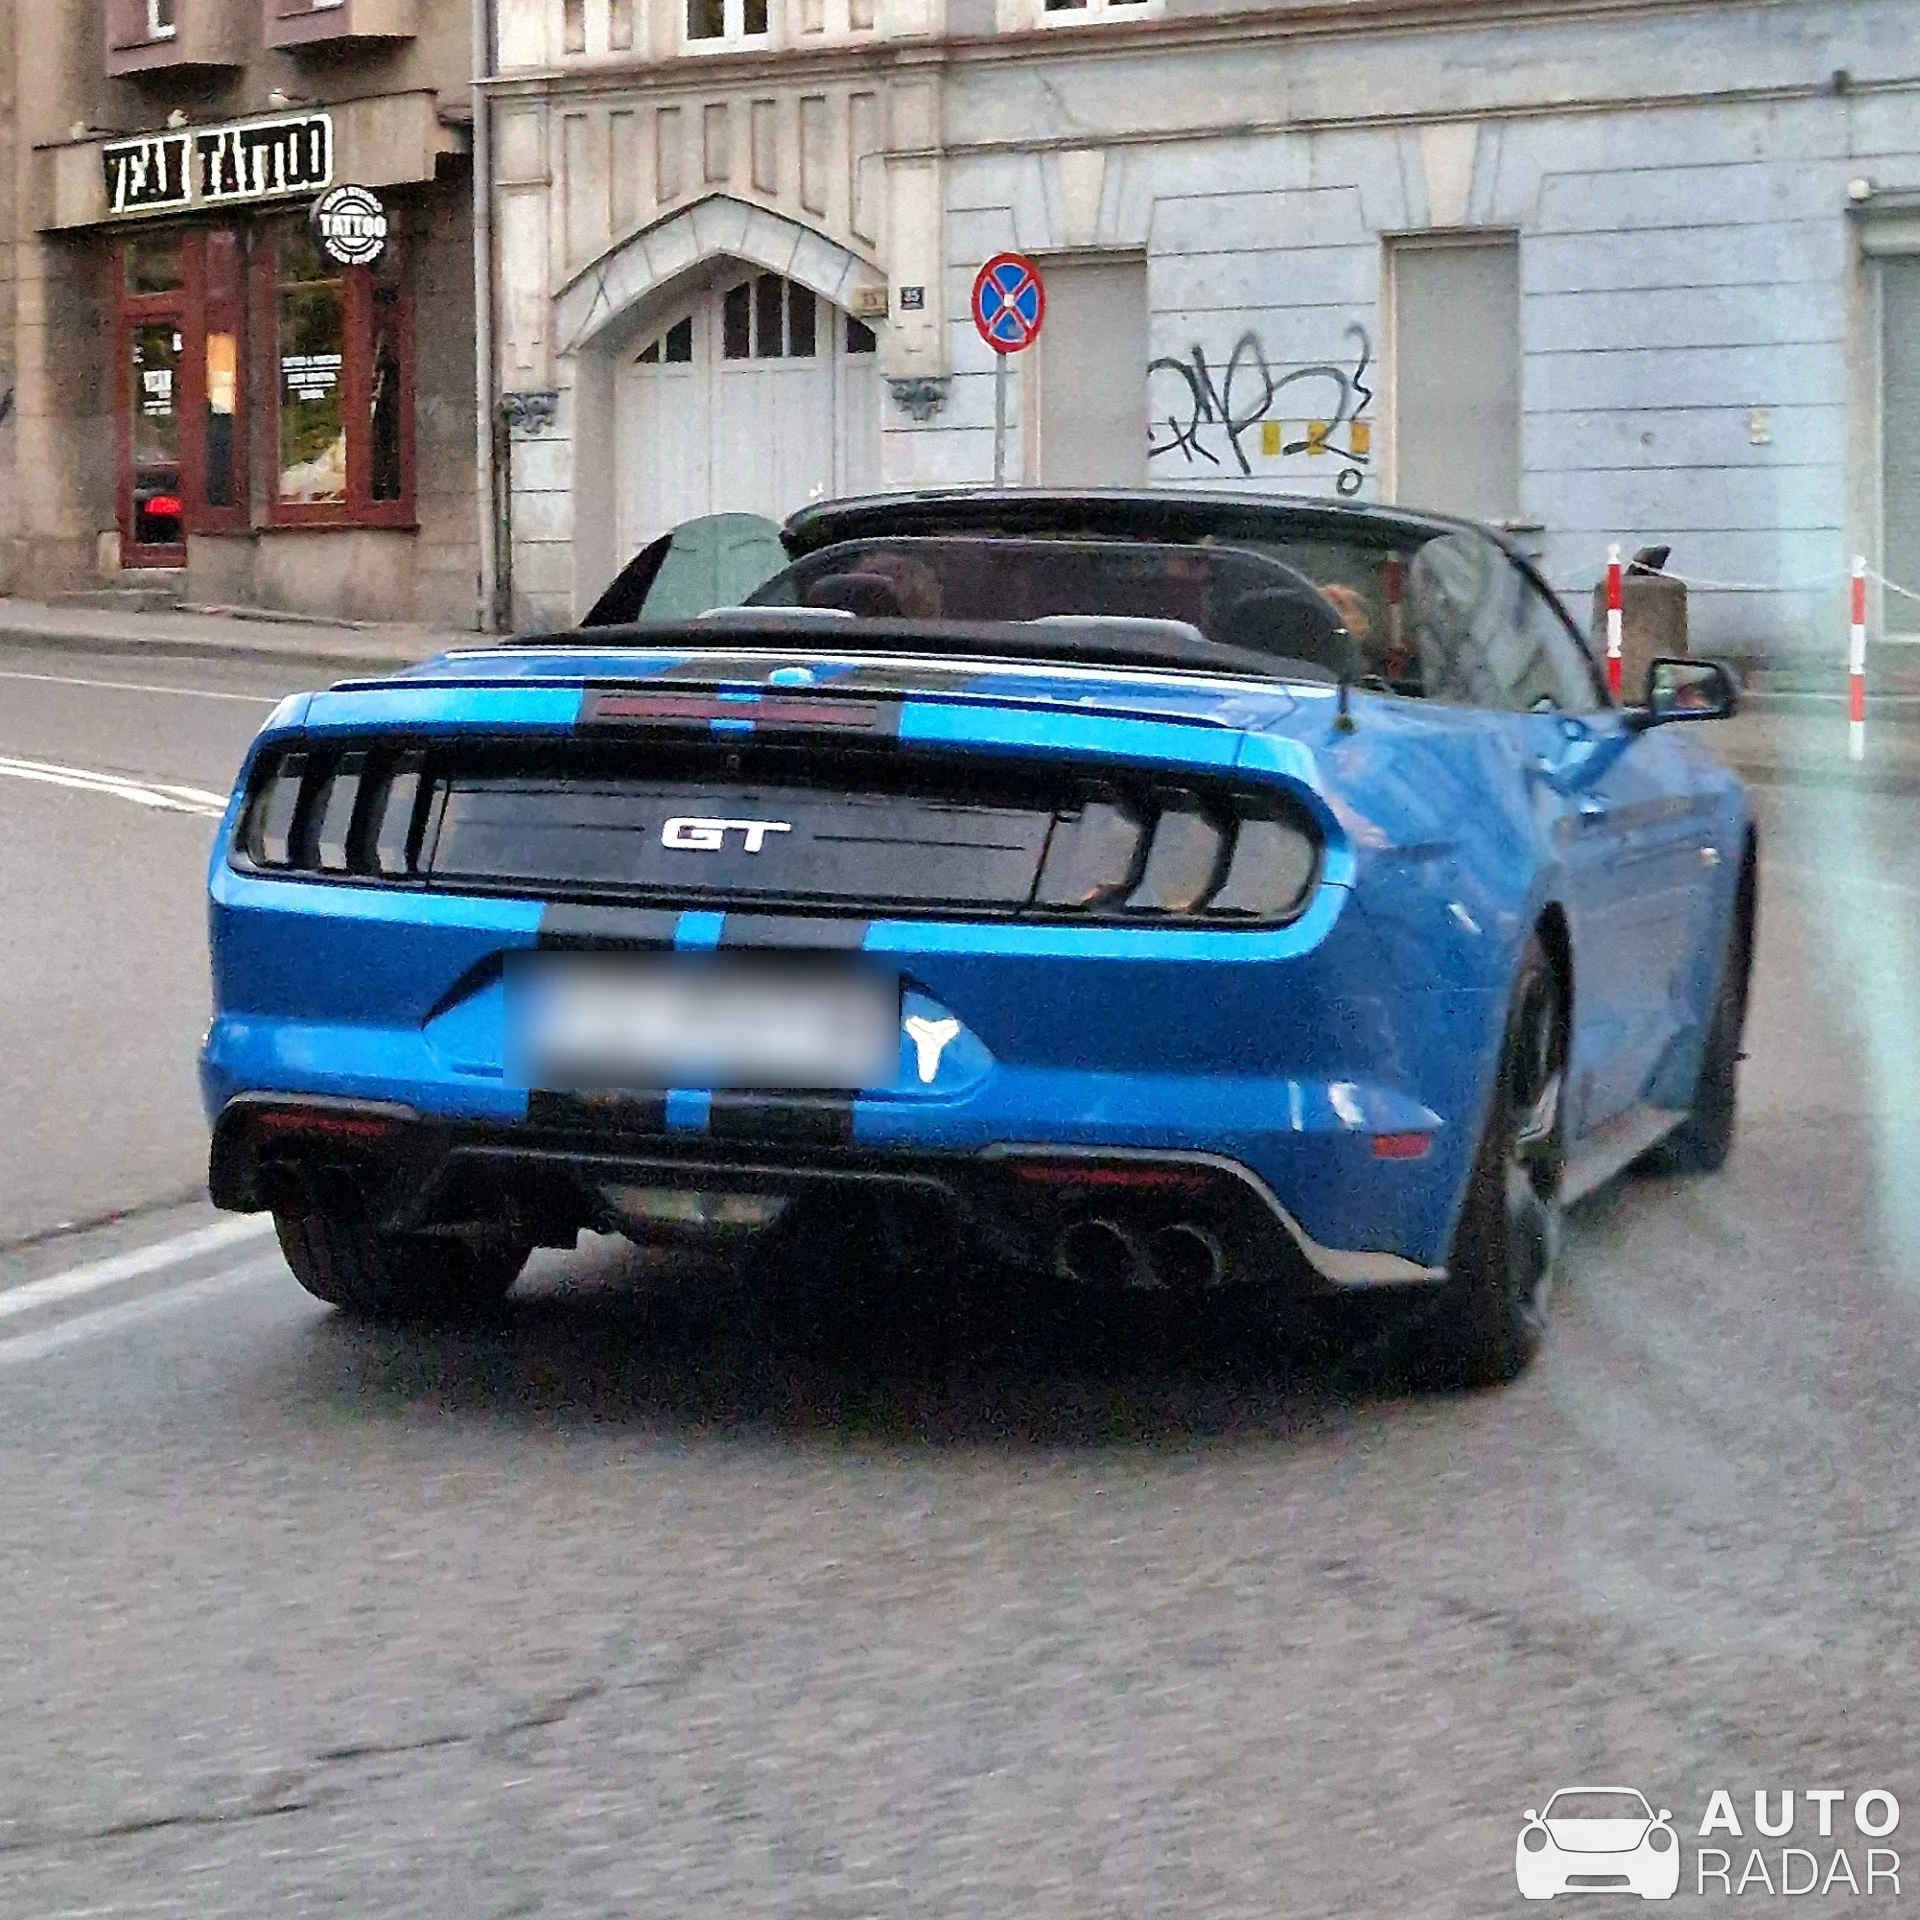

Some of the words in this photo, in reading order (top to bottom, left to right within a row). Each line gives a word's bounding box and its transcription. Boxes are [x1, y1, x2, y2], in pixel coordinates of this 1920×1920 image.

[197, 114, 333, 202] TATTOO
[319, 213, 387, 238] TATTOO
[661, 817, 792, 853] GT
